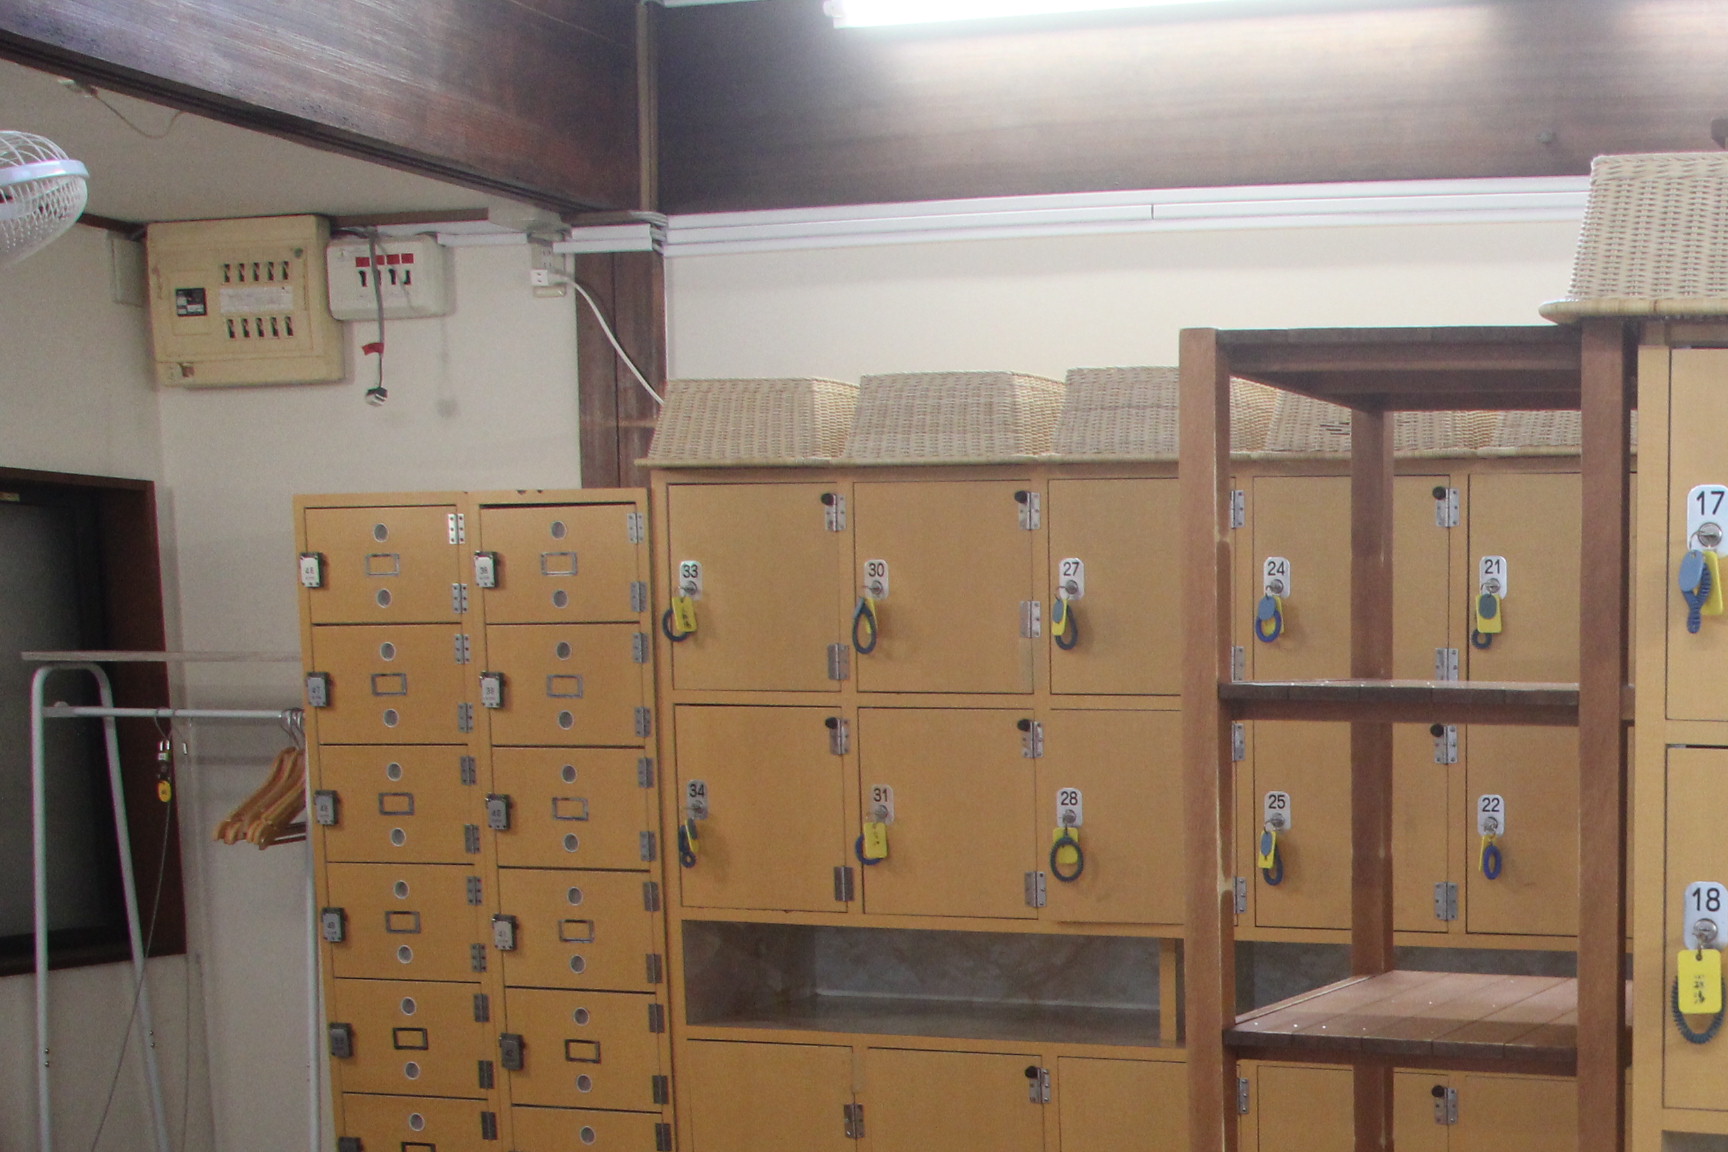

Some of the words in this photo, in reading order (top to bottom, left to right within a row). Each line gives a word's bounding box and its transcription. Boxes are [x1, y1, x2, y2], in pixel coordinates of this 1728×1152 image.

[1695, 491, 1725, 515] 17
[683, 565, 698, 578] 33
[869, 562, 884, 576] 30
[1064, 562, 1079, 575] 27
[1268, 562, 1284, 575] 24
[1485, 560, 1499, 574] 21
[689, 784, 705, 797] 34
[874, 789, 888, 802] 31
[1061, 791, 1078, 805] 28
[1269, 795, 1285, 809] 25
[1482, 798, 1500, 812] 22
[1692, 888, 1721, 911] 18
